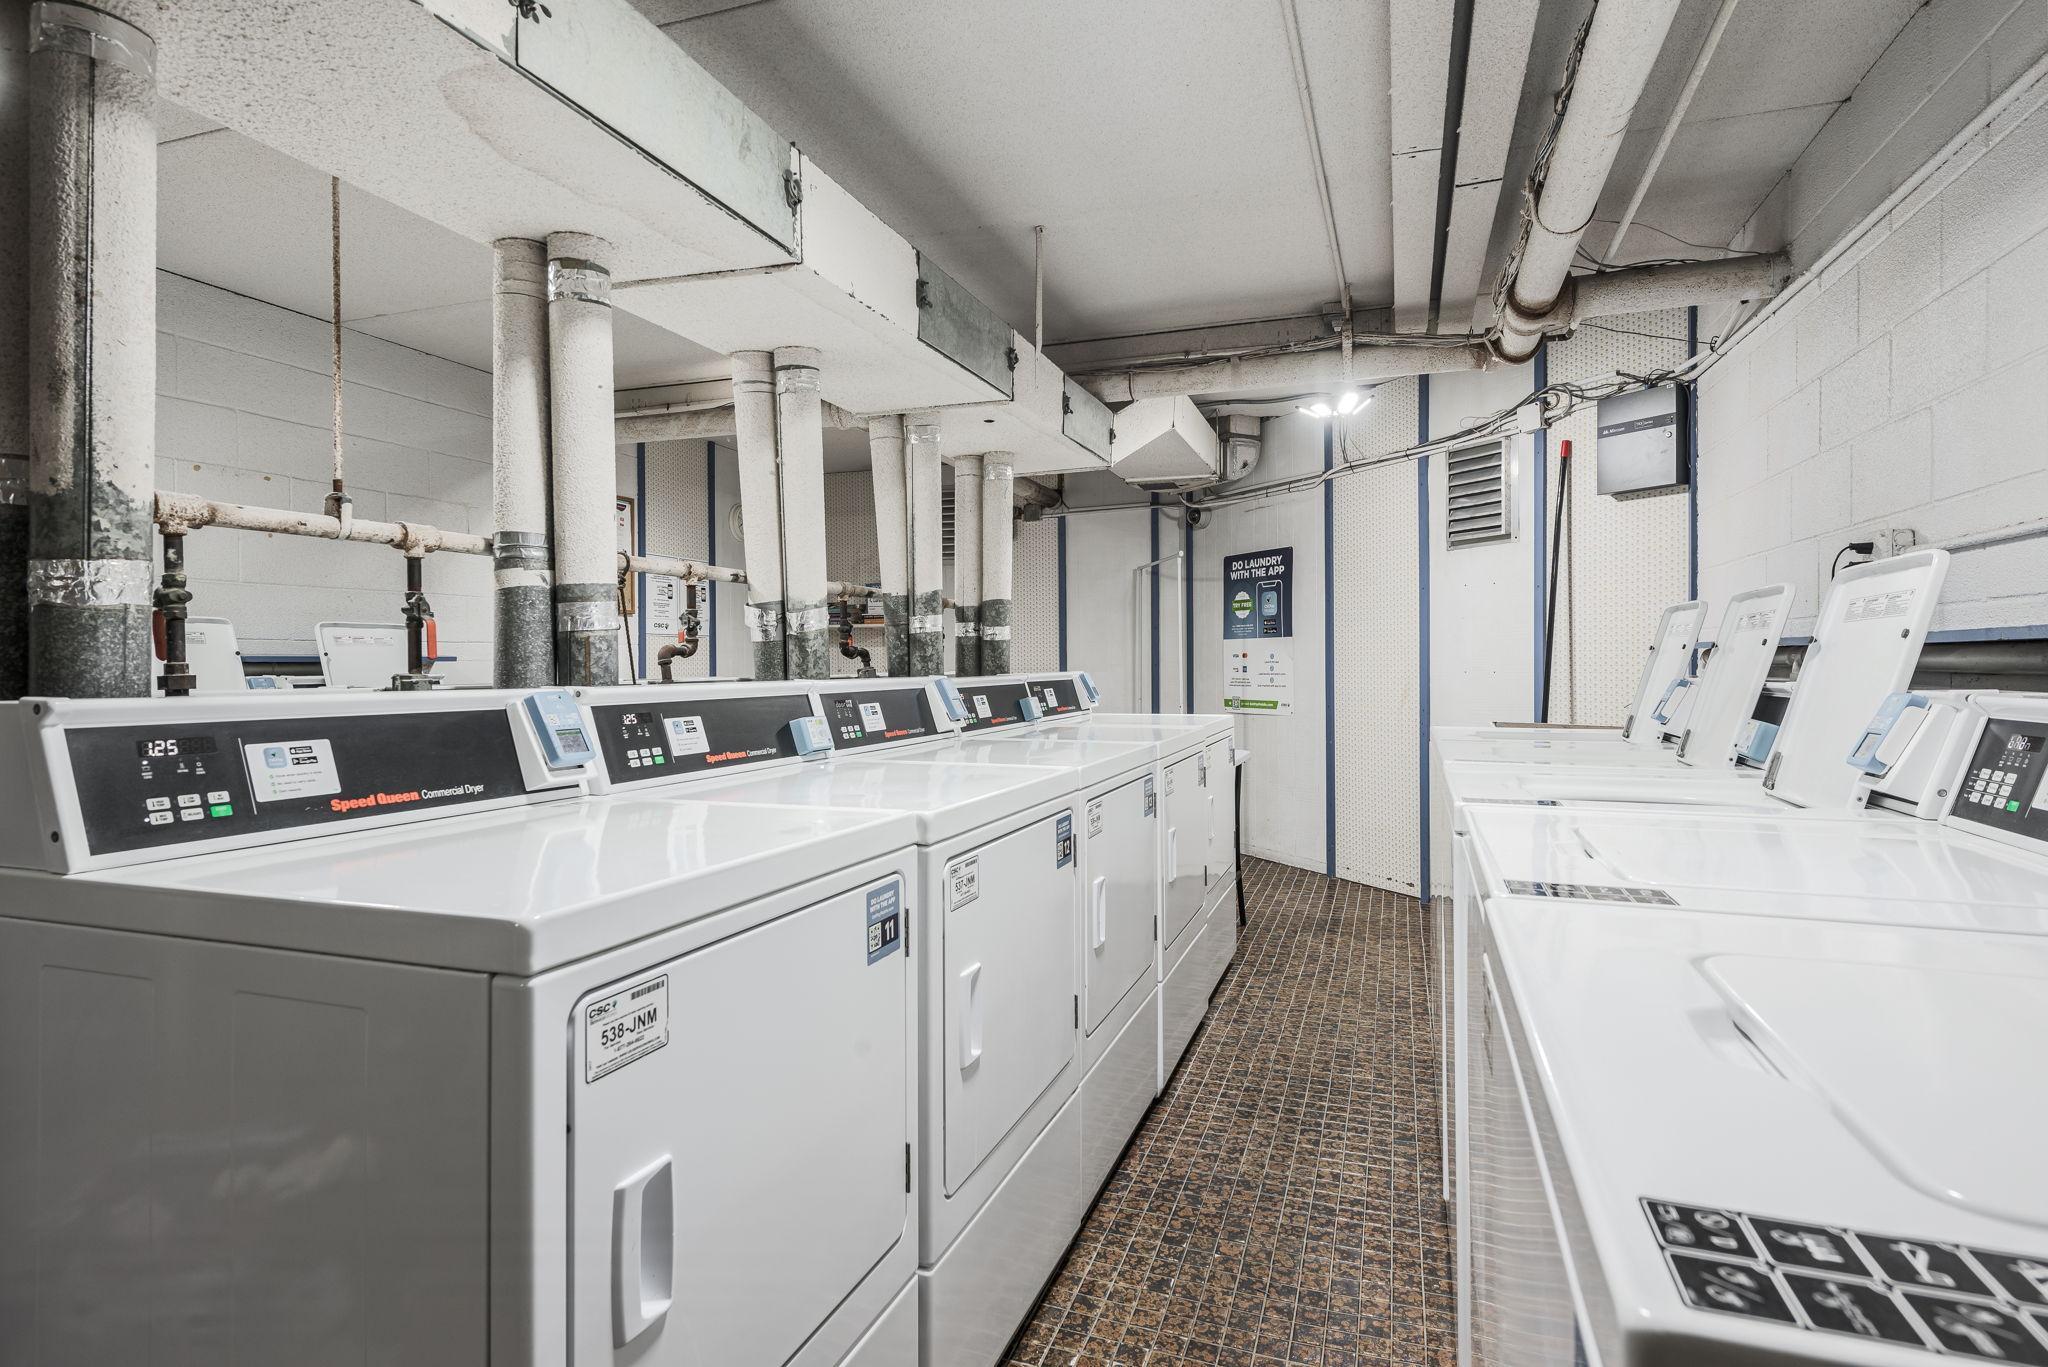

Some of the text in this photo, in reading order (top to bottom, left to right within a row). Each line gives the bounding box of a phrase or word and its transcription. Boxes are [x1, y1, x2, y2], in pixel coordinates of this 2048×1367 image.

[1232, 555, 1282, 570] DO LAUNDRY
[1230, 566, 1284, 580] WITH THE APP
[706, 752, 726, 764] Speed
[330, 784, 484, 812] Speed Queen Commercial Dryer
[884, 918, 894, 940] 11
[589, 1003, 610, 1018] CSC
[601, 1007, 657, 1046] 538-JNM
